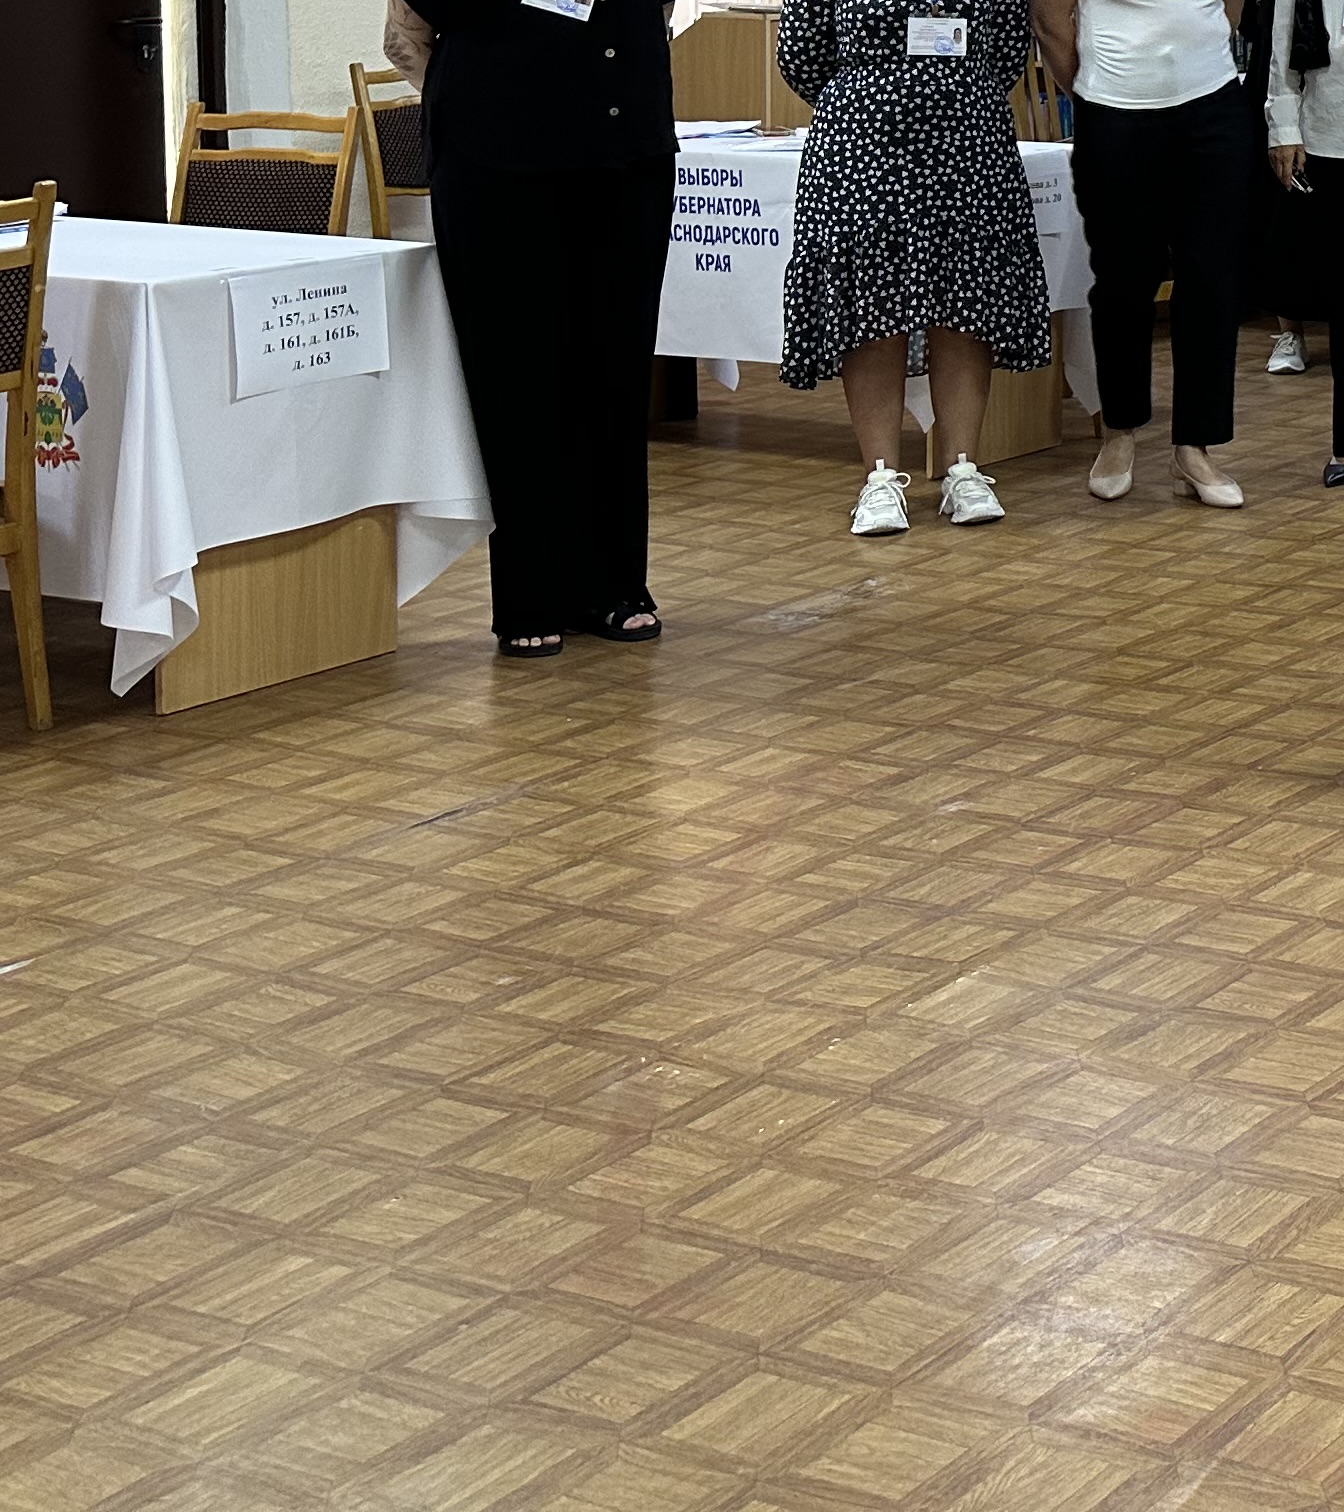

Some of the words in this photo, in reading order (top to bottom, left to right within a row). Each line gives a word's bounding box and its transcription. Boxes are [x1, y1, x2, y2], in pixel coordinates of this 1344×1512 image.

[678, 167, 743, 187] ВЫБОРЫ
[695, 253, 732, 272] КРАЯ
[271, 296, 292, 309] ул.
[295, 284, 348, 302] Ленина
[262, 320, 274, 332] д.
[278, 312, 305, 328] 157,
[308, 312, 320, 324] д.
[324, 303, 359, 320] 157А,
[262, 344, 275, 355] д.
[280, 334, 306, 350] 161,
[308, 335, 321, 346] д.
[325, 325, 359, 342] 161Б,
[292, 360, 305, 372] д.
[309, 351, 331, 367] 163
